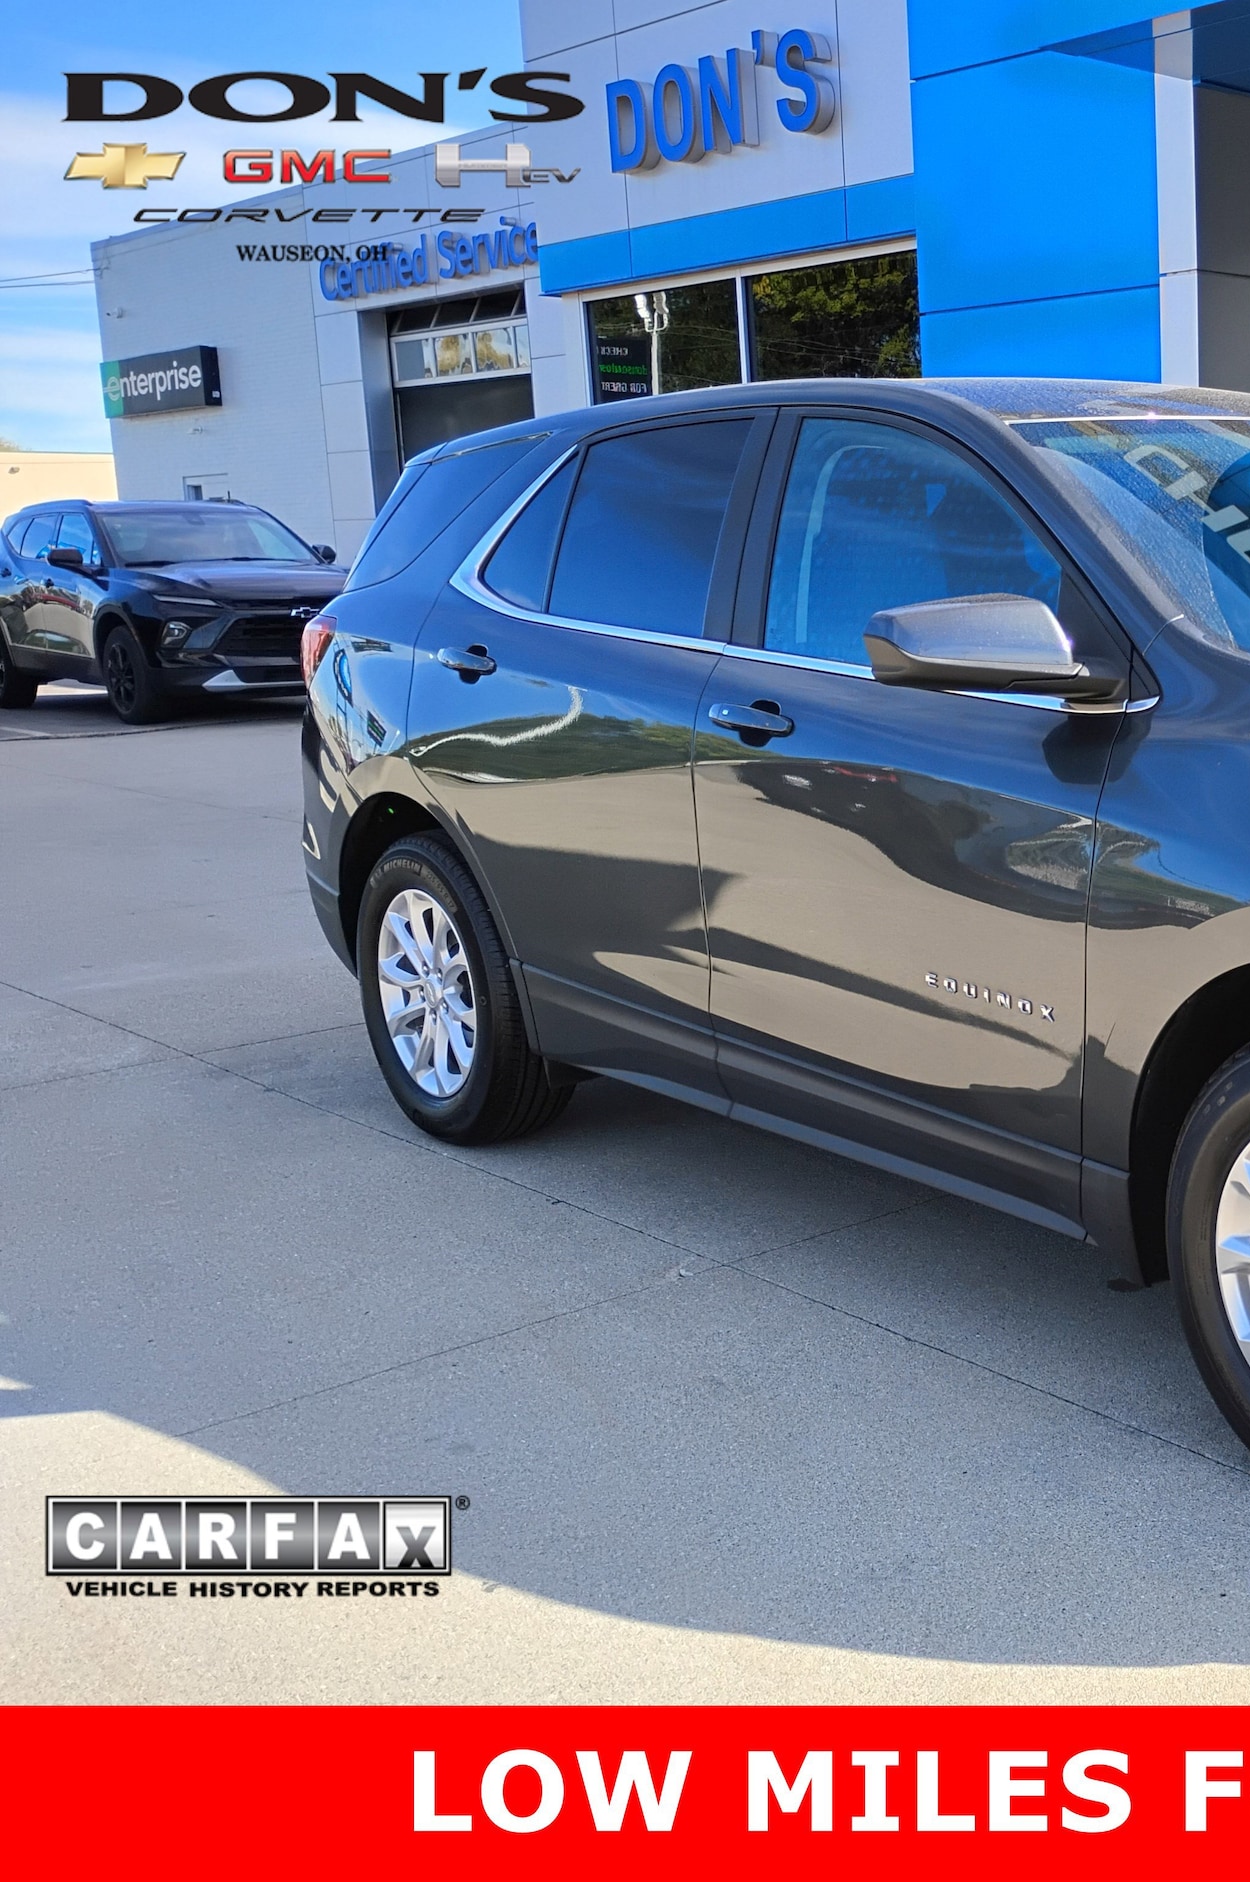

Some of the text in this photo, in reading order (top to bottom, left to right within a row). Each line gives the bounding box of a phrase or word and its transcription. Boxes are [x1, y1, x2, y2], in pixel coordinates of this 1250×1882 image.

[606, 29, 832, 173] DON'S
[319, 216, 538, 301] Certified Service
[106, 360, 202, 401] enterprise
[383, 859, 422, 874] MICHELIN
[925, 972, 1055, 1023] EQUINOX
